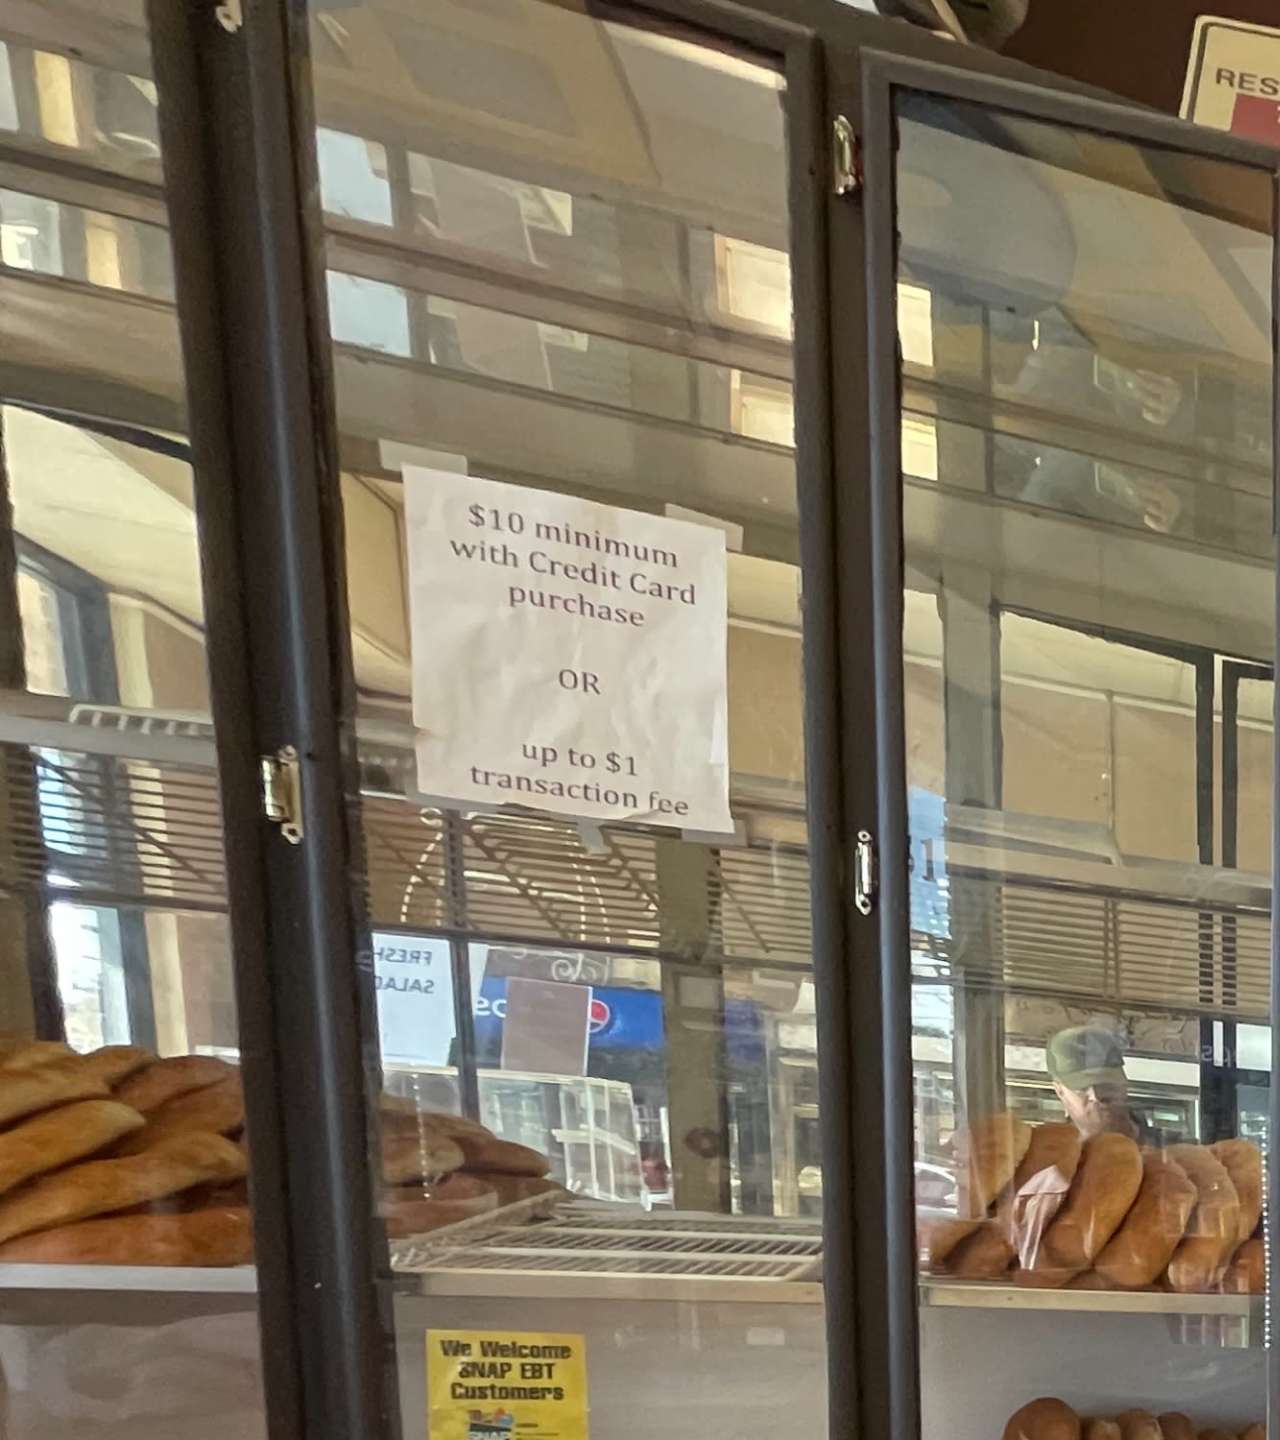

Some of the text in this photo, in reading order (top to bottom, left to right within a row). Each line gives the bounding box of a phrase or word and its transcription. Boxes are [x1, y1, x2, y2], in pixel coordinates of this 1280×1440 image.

[468, 504, 679, 568] $10 minimum
[450, 539, 697, 605] with Credit Card
[508, 584, 646, 627] purchase
[558, 669, 601, 695] OR
[521, 744, 639, 776] up to $1
[470, 766, 689, 816] transaction fee
[440, 1339, 572, 1360] We Welcome
[459, 1362, 556, 1380] SNAP EBT
[451, 1382, 564, 1401] Customers
